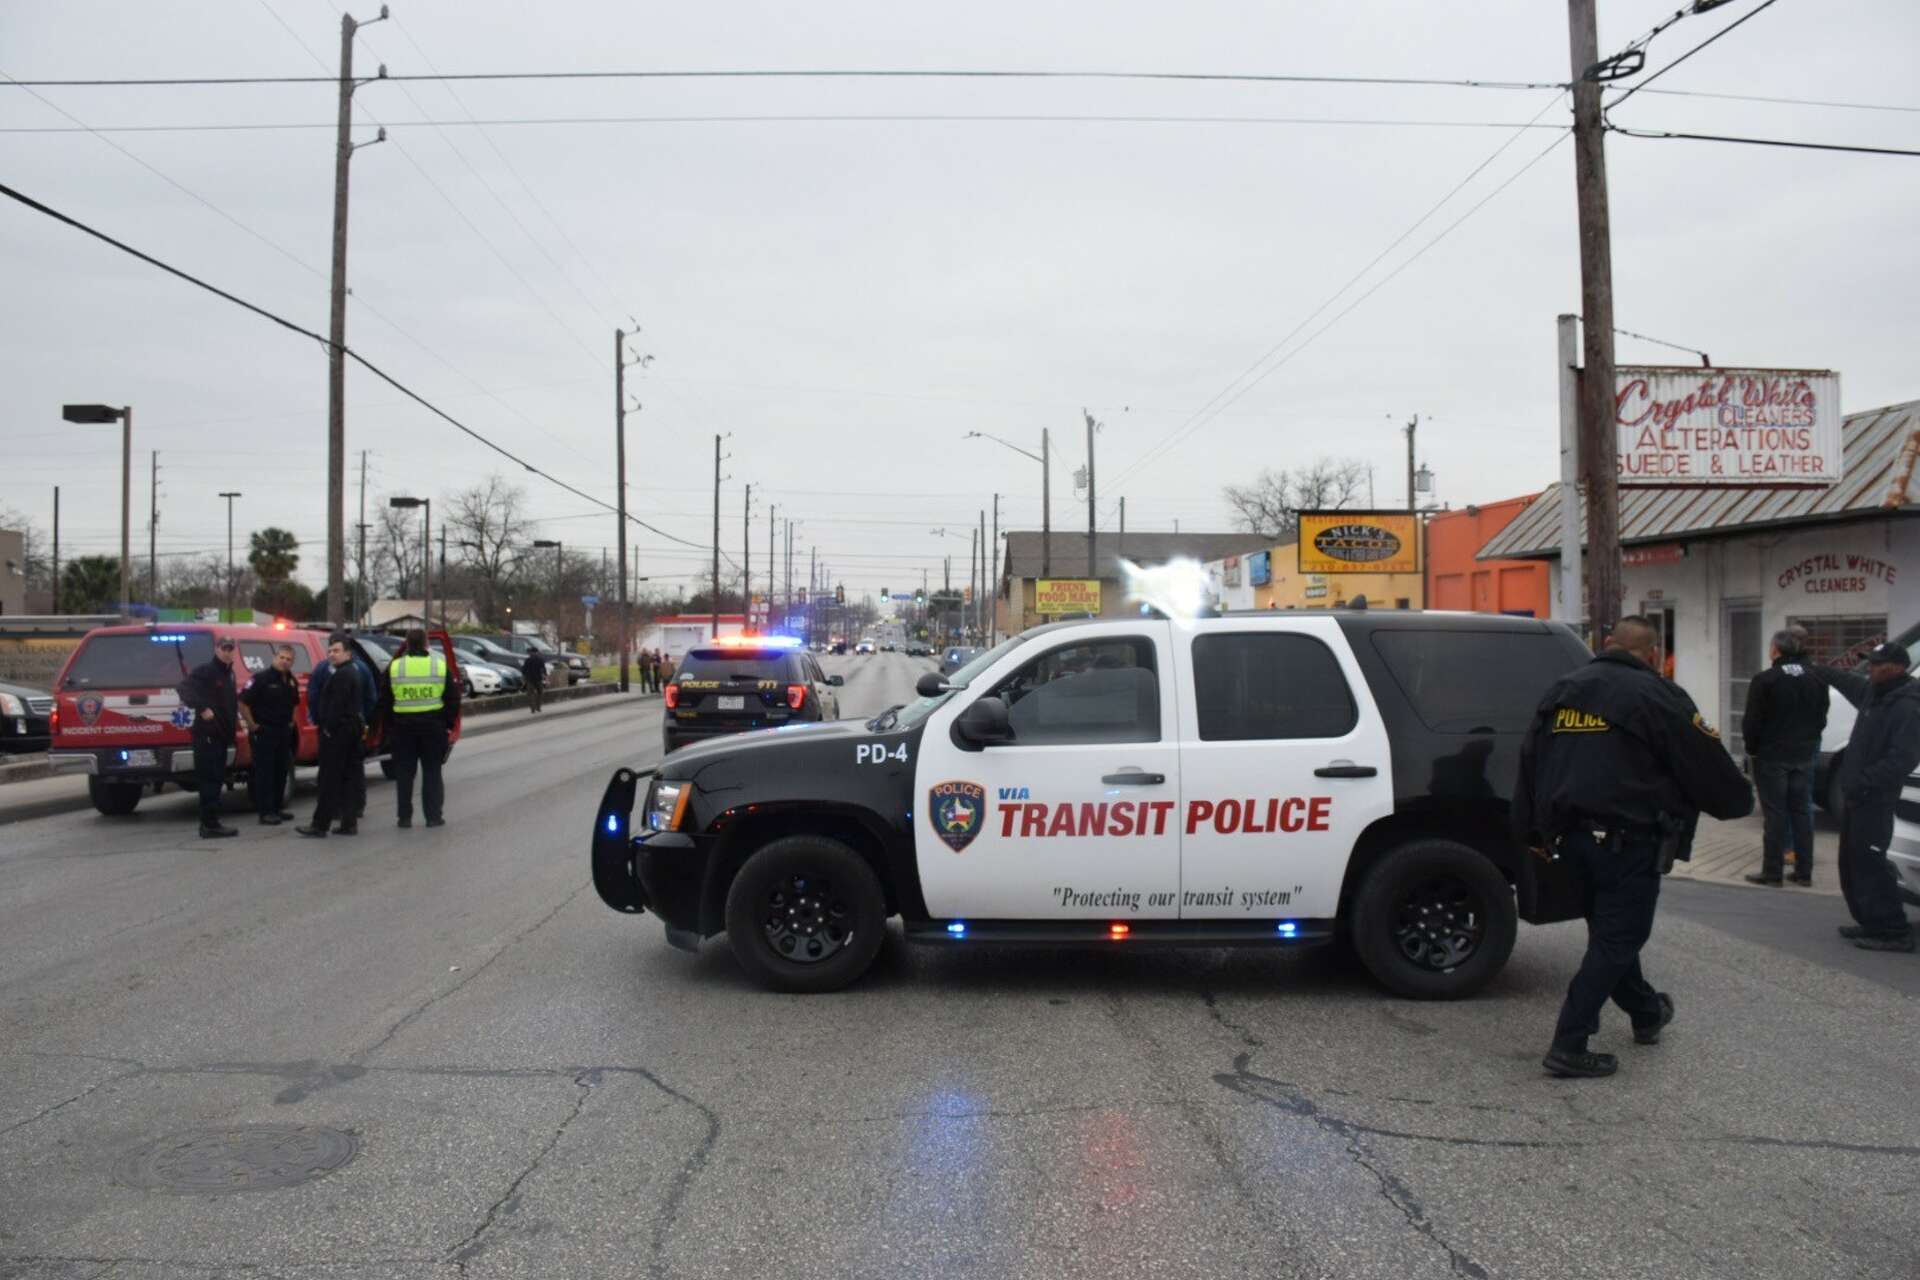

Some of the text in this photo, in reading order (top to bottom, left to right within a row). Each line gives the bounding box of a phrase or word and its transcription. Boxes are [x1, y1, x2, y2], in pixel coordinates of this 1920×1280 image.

[1615, 376, 1816, 430] Crystal White
[1636, 426, 1811, 450] ALTERATIONS
[1711, 453, 1724, 474] &
[1738, 454, 1824, 474] LEATHER
[1777, 554, 1897, 588] CRYSTAL WHITE
[1805, 577, 1867, 593] CLEANERS
[402, 687, 433, 698] POLICE
[681, 681, 720, 689] POLICE
[104, 724, 163, 734] COMMANDER
[856, 742, 908, 764] PD-4
[934, 783, 982, 799] POLICE
[998, 787, 1030, 800] VIA
[998, 797, 1332, 837] TRANSIT POLICE
[1053, 885, 1303, 912] "Protecting our transit system"
